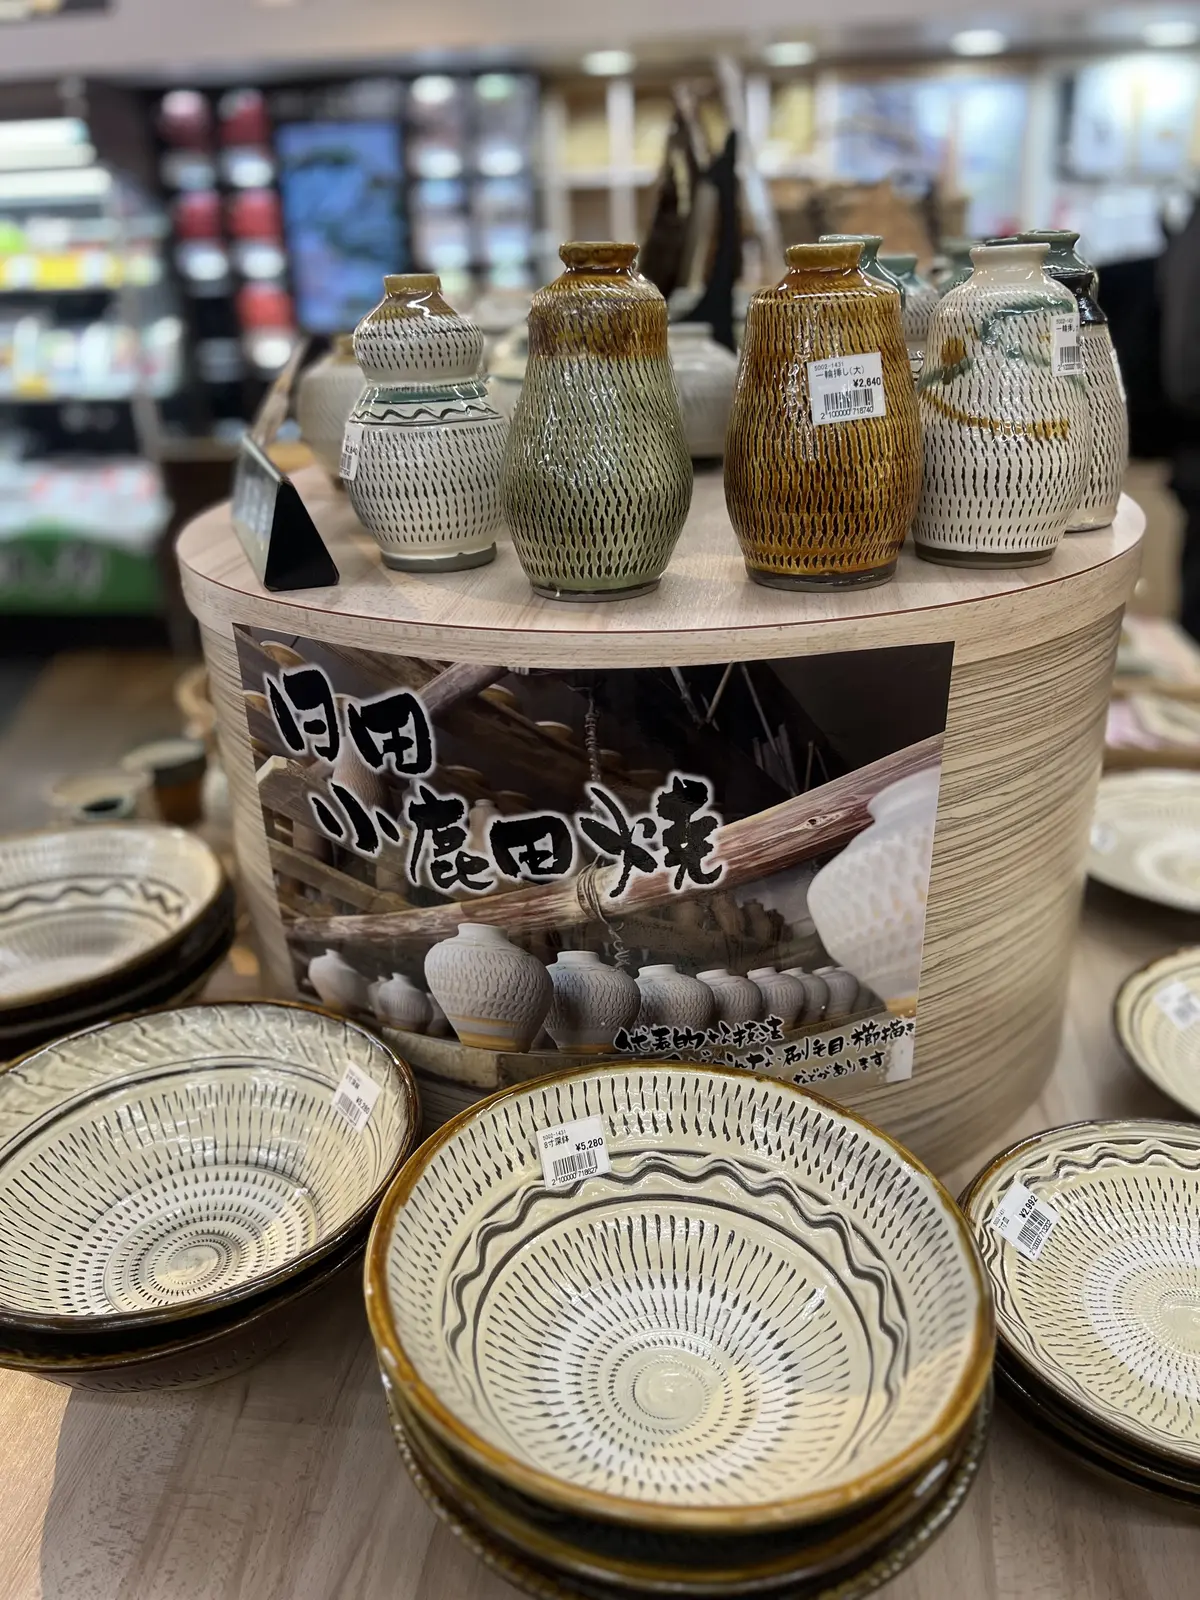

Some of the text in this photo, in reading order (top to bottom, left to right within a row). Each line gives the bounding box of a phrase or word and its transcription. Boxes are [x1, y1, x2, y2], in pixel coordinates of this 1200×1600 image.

[814, 361, 844, 371] 5002-1431
[852, 376, 881, 388] ¥2,640
[820, 412, 826, 420] 2
[264, 668, 434, 775] 日田
[311, 776, 722, 898] 小鹿田焼
[615, 1015, 785, 1050] 代表的な技法
[575, 1137, 604, 1152] ¥5,280
[551, 1178, 556, 1186] 2
[1018, 1195, 1039, 1219] ¥2,992
